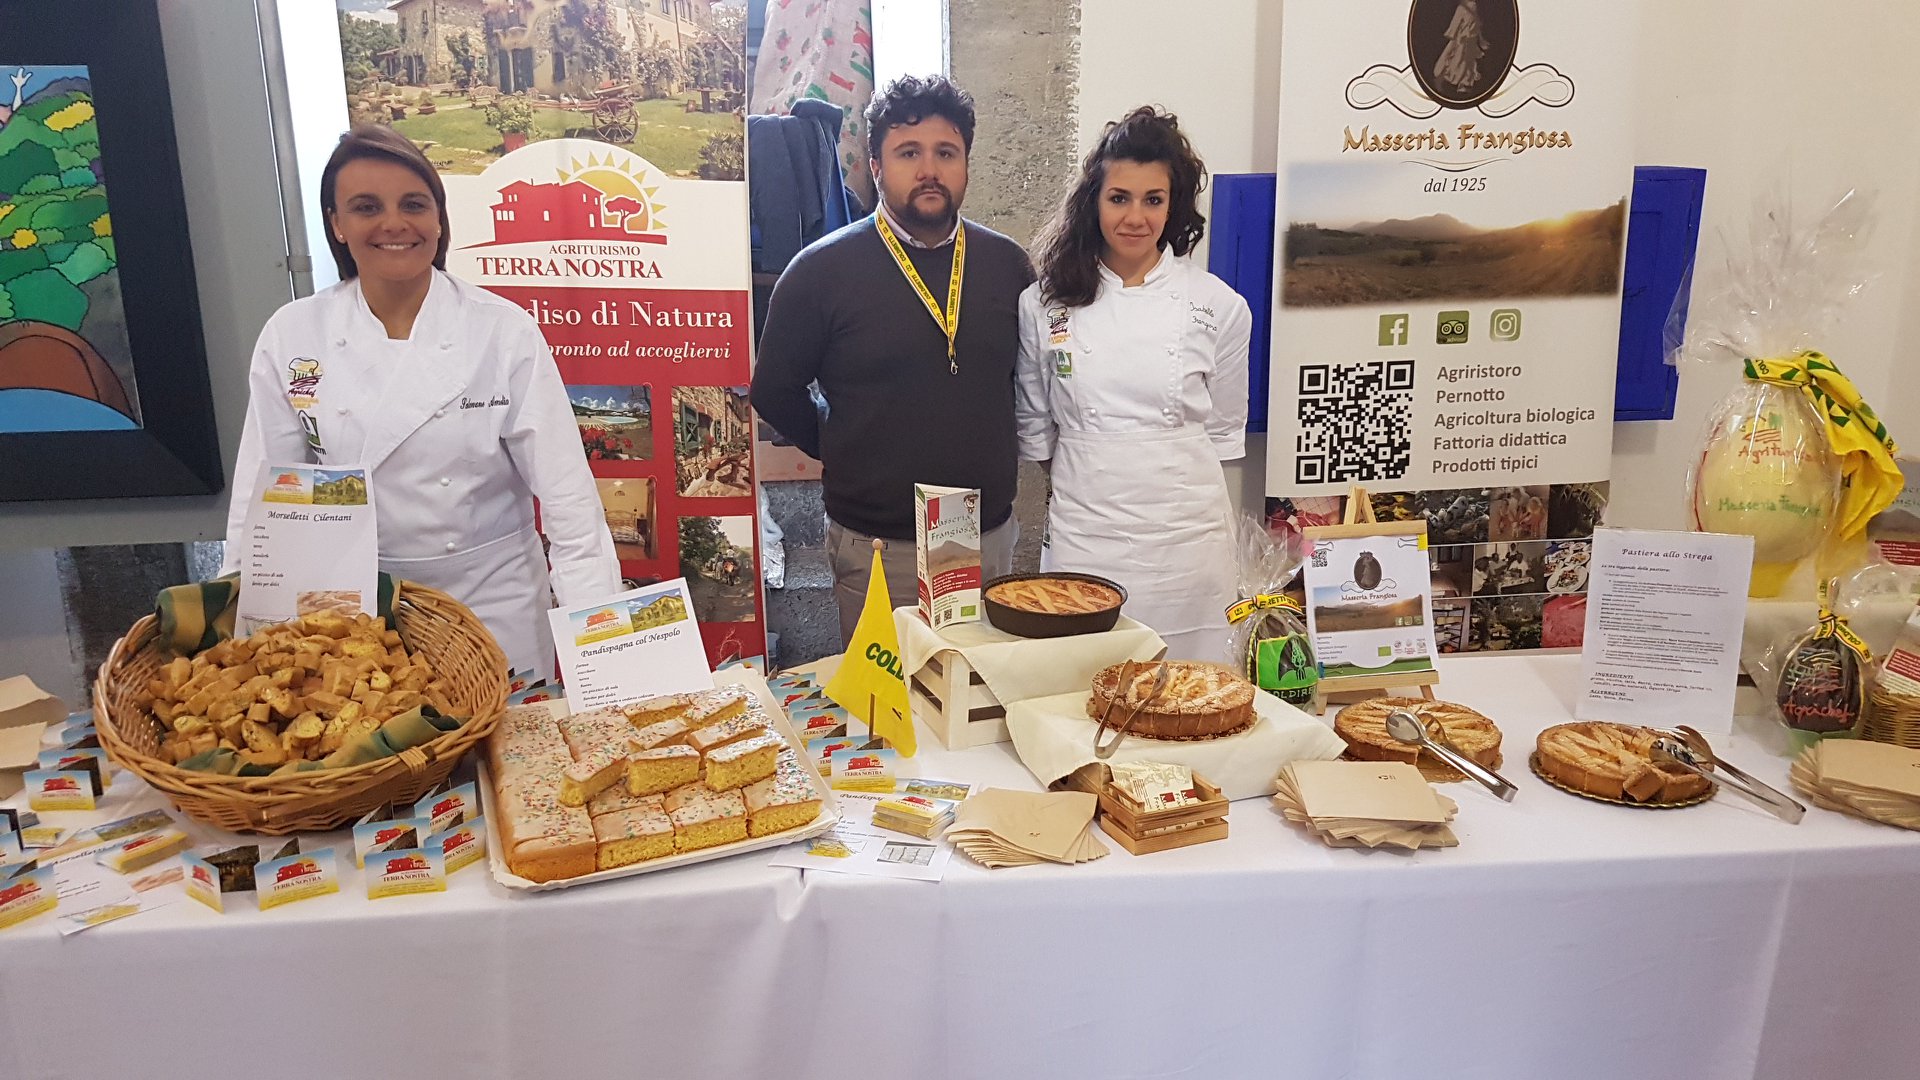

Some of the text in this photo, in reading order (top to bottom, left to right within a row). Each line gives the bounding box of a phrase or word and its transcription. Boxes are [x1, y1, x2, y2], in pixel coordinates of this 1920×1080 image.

[1342, 123, 1573, 154] Masseria Frangiosa
[1423, 177, 1487, 193] dal 1925
[549, 244, 641, 256] AGRITURISMO
[476, 256, 663, 279] TERRA NOSTRA
[591, 300, 619, 326] di
[628, 301, 734, 328] Natura
[606, 341, 630, 358] ad
[635, 342, 731, 364] accogliervi
[1437, 364, 1522, 382] Agriristoro
[1436, 387, 1506, 404] Pernotto
[1434, 407, 1596, 429] Agricoltura biologica
[1433, 431, 1568, 451] Fattoria didattica
[1432, 455, 1539, 474] Prodotti tipici
[267, 510, 352, 522] Morselletti Cilentani
[1621, 548, 1713, 562] Pastiera allo Strega
[580, 641, 634, 658] Pandispagna
[635, 634, 648, 646] col
[648, 627, 681, 643] Nespolo
[272, 874, 322, 892] TERRA NOSTRA
[383, 870, 430, 882] TERRA NOSTRA
